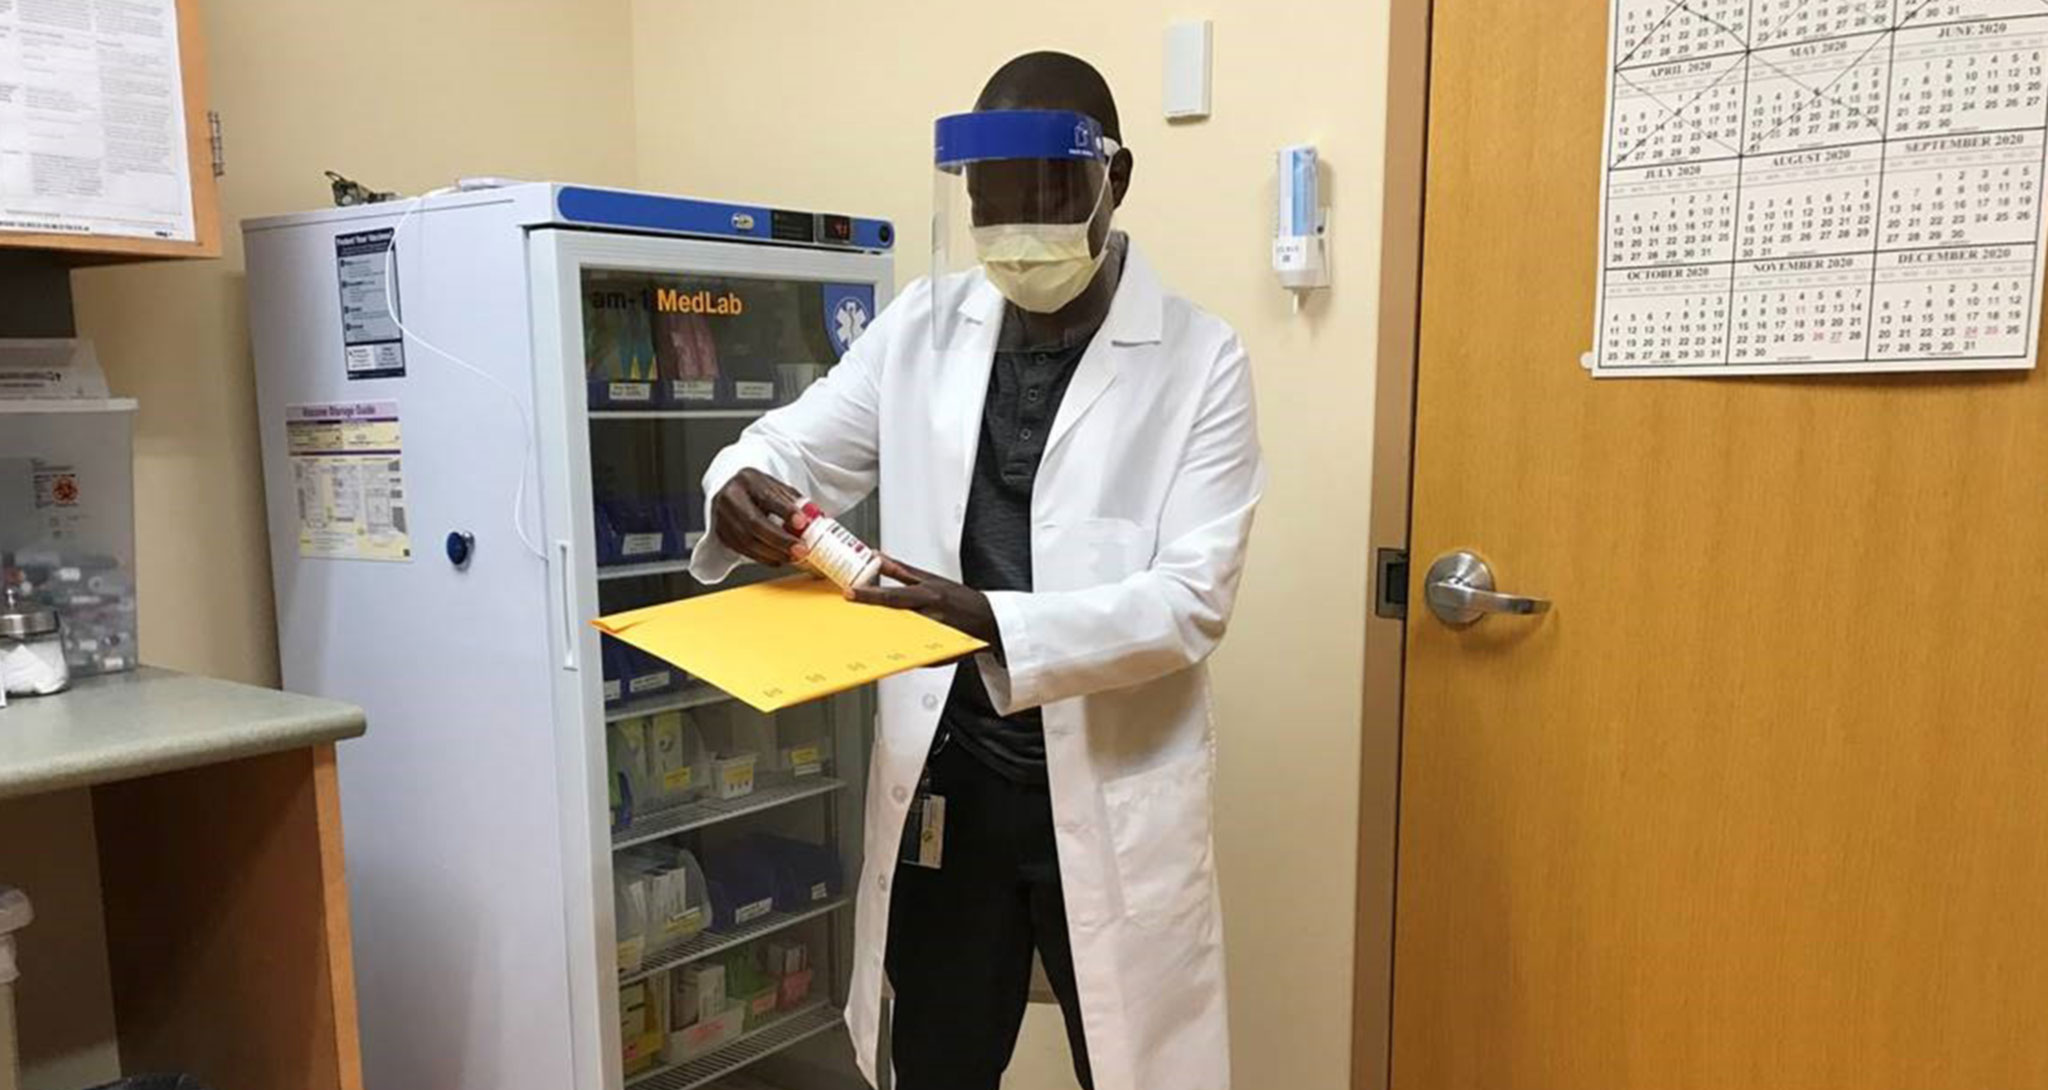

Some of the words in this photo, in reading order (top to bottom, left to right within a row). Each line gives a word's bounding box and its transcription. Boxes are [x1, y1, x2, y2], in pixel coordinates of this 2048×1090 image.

[1938, 26, 1975, 38] JUNE
[1978, 23, 2007, 35] 2020
[1965, 70, 1978, 80] 10
[1987, 69, 1998, 78] 11
[2008, 67, 2020, 77] 12
[2028, 66, 2041, 75] 13
[1920, 90, 1932, 99] 15
[1941, 88, 1953, 97] 16
[1964, 85, 1976, 95] 17
[1987, 84, 1998, 93] 18
[2007, 82, 2020, 92] 19
[2027, 81, 2041, 91] 20
[1917, 105, 1931, 115] 22
[1939, 103, 1952, 113] 23
[1961, 101, 1975, 111] 24
[1985, 99, 1997, 109] 25
[2005, 98, 2018, 107] 26
[2026, 96, 2040, 106] 27
[1905, 137, 1991, 152] SEPTEMBER
[1995, 134, 2024, 146] 2020
[1771, 153, 1820, 166] AUGUST
[1825, 150, 1851, 162] 2020
[1645, 168, 1672, 179] JULY
[1678, 166, 1701, 177] 2020
[1977, 183, 1990, 192] 10
[1998, 182, 2009, 190] 11
[2019, 180, 2032, 190] 12
[1889, 204, 1901, 213] 13
[1911, 203, 1921, 211] 14
[1931, 201, 1944, 210] 15
[1954, 199, 1966, 209] 16
[1977, 197, 1990, 207] 17
[2019, 195, 2031, 205] 19
[1886, 219, 1900, 228] 20
[1908, 218, 1920, 227] 21
[1929, 216, 1943, 225] 22
[1951, 214, 1965, 224] 23
[1975, 213, 1988, 222] 24
[1995, 212, 2008, 221] 25
[2016, 211, 2030, 220] 26
[1907, 232, 1920, 241] 28
[1928, 231, 1941, 240] 29
[1898, 250, 1978, 264] DECEMBER
[1982, 248, 2011, 259] 2020
[1753, 260, 1824, 272] NOVEMBER
[1827, 258, 1853, 269] 2020
[1627, 269, 1683, 280] OCTOBER
[1686, 267, 1709, 278] 2020
[657, 289, 742, 315] MedLab
[1814, 304, 1825, 313] 12
[1833, 303, 1844, 312] 13
[1738, 321, 1748, 330] 15
[1757, 321, 1766, 329] 16
[1774, 320, 1785, 328] 17
[1794, 319, 1805, 328] 18
[1814, 318, 1825, 327] 19
[1830, 317, 1843, 326] 20
[1849, 317, 1861, 326] 21
[1880, 315, 1892, 324] 13
[1901, 314, 1912, 323] 14
[1921, 313, 1934, 323] 15
[1944, 313, 1955, 321] 16
[1966, 311, 1979, 320] 17
[1987, 311, 1999, 319] 18
[2008, 310, 2020, 318] 19
[1609, 326, 1619, 334] 11
[1627, 326, 1637, 334] 12
[1644, 325, 1655, 334] 13
[1661, 324, 1673, 333] 14
[1680, 324, 1690, 332] 15
[1712, 322, 1723, 331] 17
[1878, 329, 1891, 338] 20
[1898, 328, 1910, 337] 21
[1919, 327, 1932, 337] 22
[1942, 327, 1955, 336] 23
[1609, 339, 1619, 347] 18
[1642, 338, 1654, 347] 20
[1660, 337, 1670, 346] 21
[1678, 337, 1689, 345] 22
[1711, 336, 1722, 345] 24
[1755, 334, 1766, 343] 23
[1773, 334, 1784, 342] 24
[1792, 333, 1804, 342] 25
[1735, 348, 1747, 357] 29
[1877, 343, 1890, 352] 27
[1898, 343, 1910, 352] 28
[1918, 342, 1932, 351] 29
[1941, 341, 1954, 351] 30
[1963, 340, 1975, 350] 31
[1607, 352, 1618, 360] 25
[1624, 352, 1635, 360] 26
[1642, 350, 1653, 359] 27
[1677, 350, 1689, 358] 29
